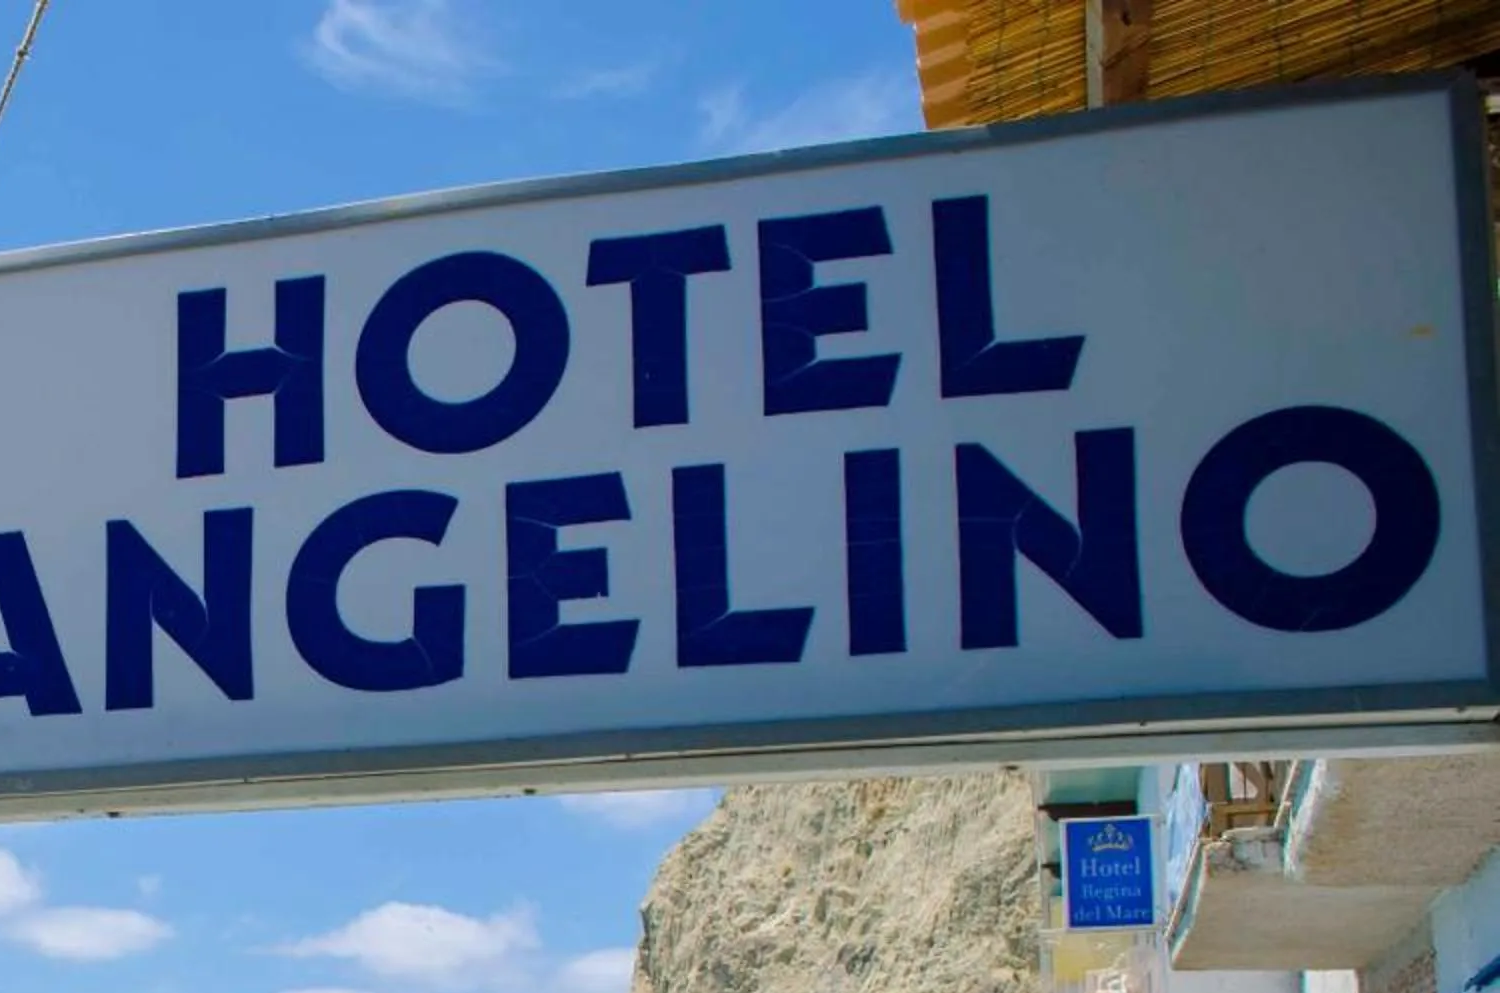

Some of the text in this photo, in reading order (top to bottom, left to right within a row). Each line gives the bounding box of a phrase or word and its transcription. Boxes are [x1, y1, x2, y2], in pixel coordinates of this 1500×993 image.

[176, 194, 1085, 478] HOTEL
[1080, 856, 1141, 878] Hotel
[1082, 883, 1142, 900] Regina
[1074, 904, 1150, 921] del Mare
